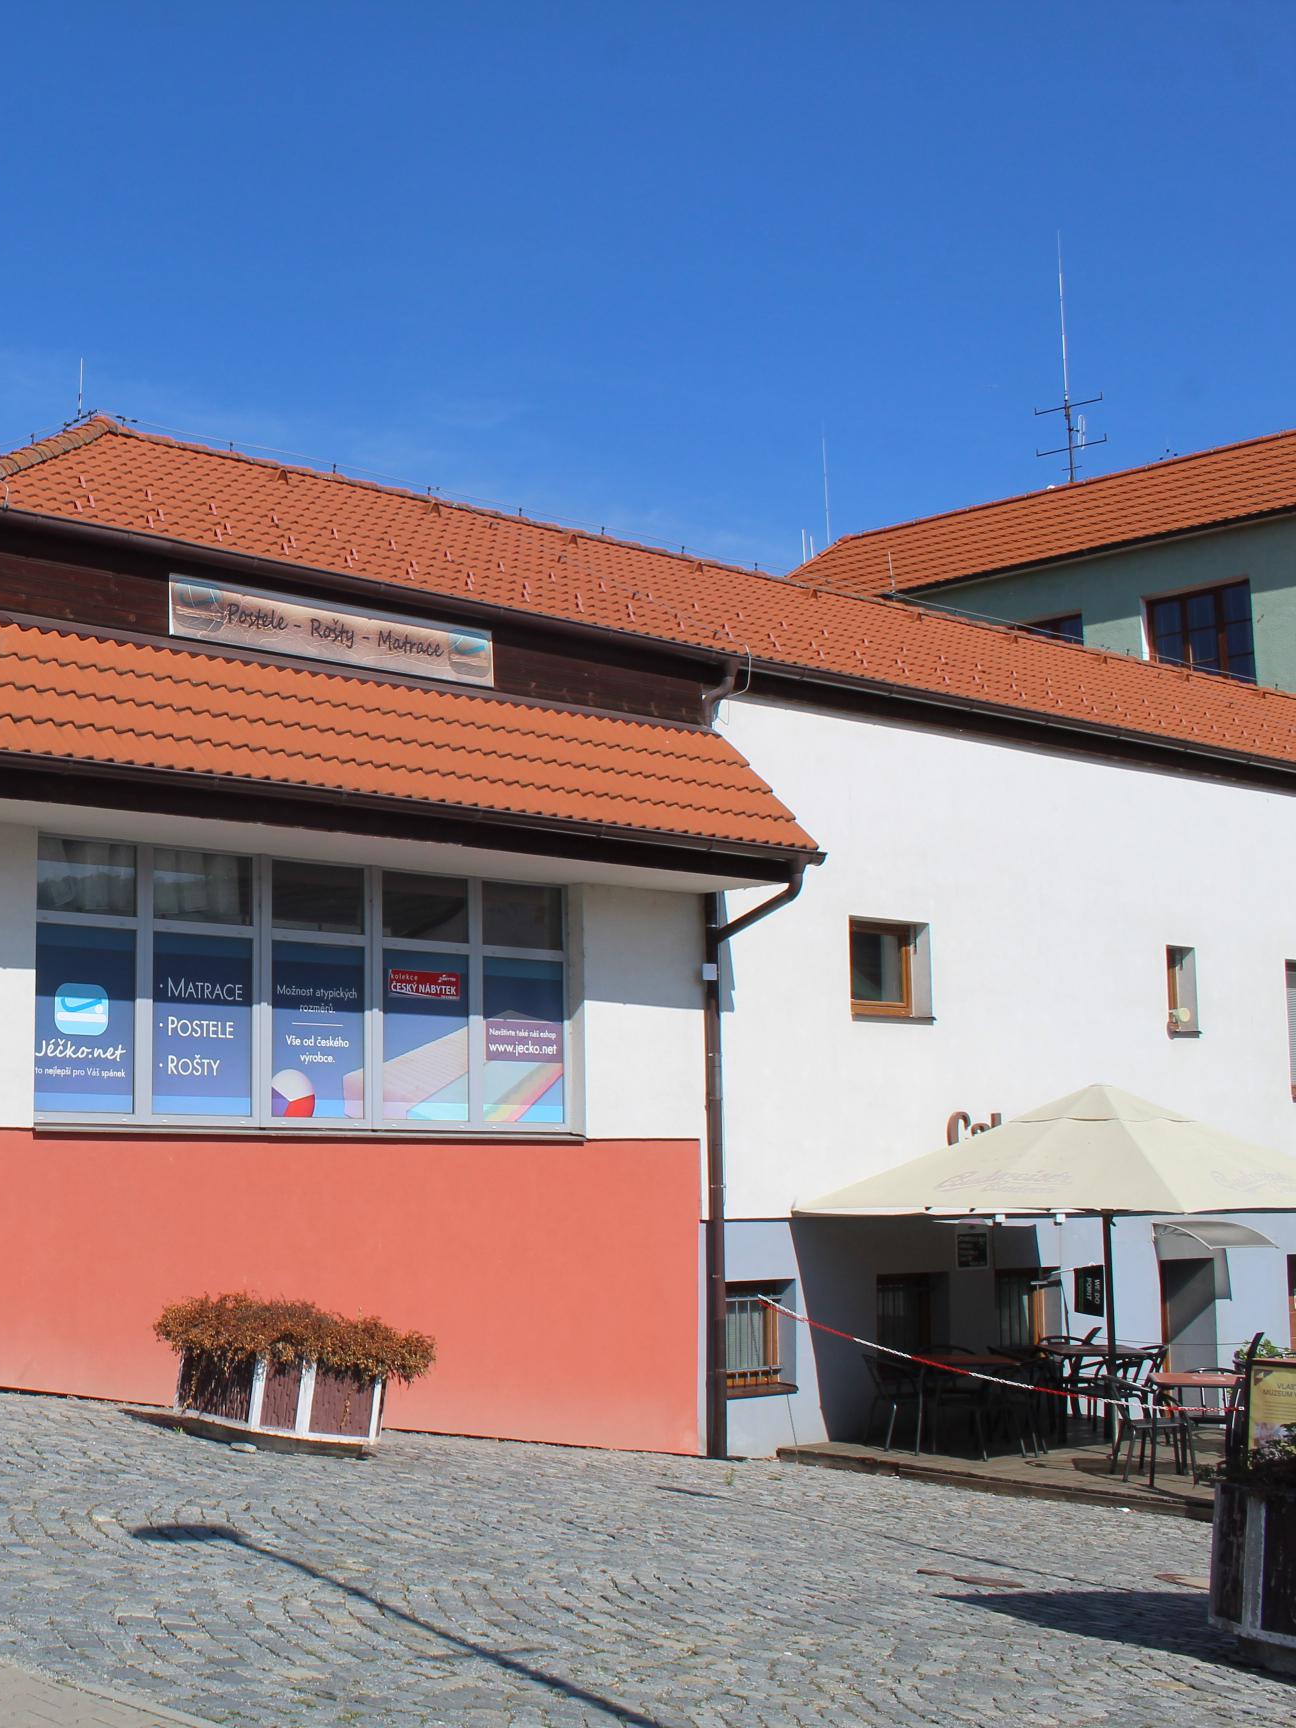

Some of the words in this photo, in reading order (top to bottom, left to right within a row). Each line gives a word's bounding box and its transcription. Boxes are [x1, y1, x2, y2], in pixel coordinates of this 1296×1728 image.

[227, 602, 288, 631] Postele
[310, 618, 354, 649] Rošty
[377, 630, 445, 658] Matrace
[390, 973, 418, 981] kolekce
[168, 977, 243, 1000] MATRACE
[277, 984, 313, 998] Možnost
[315, 986, 357, 1000] atypických
[391, 981, 417, 993] ČESKÝ
[419, 983, 456, 995] NÁBYTEK
[299, 1002, 336, 1014] rozměrů.
[168, 1016, 234, 1038] POSTELE
[285, 1035, 301, 1047] Vše
[303, 1036, 314, 1047] od
[316, 1035, 350, 1048] českého
[540, 1030, 556, 1040] eshop
[35, 1038, 126, 1062] Jéčko.net
[489, 1040, 557, 1056] www.jecko.net
[299, 1051, 336, 1063] výrobce.
[72, 1069, 85, 1078] pro
[87, 1067, 99, 1077] Váš
[101, 1068, 126, 1079] spánek
[168, 1055, 220, 1076] ROŠTY
